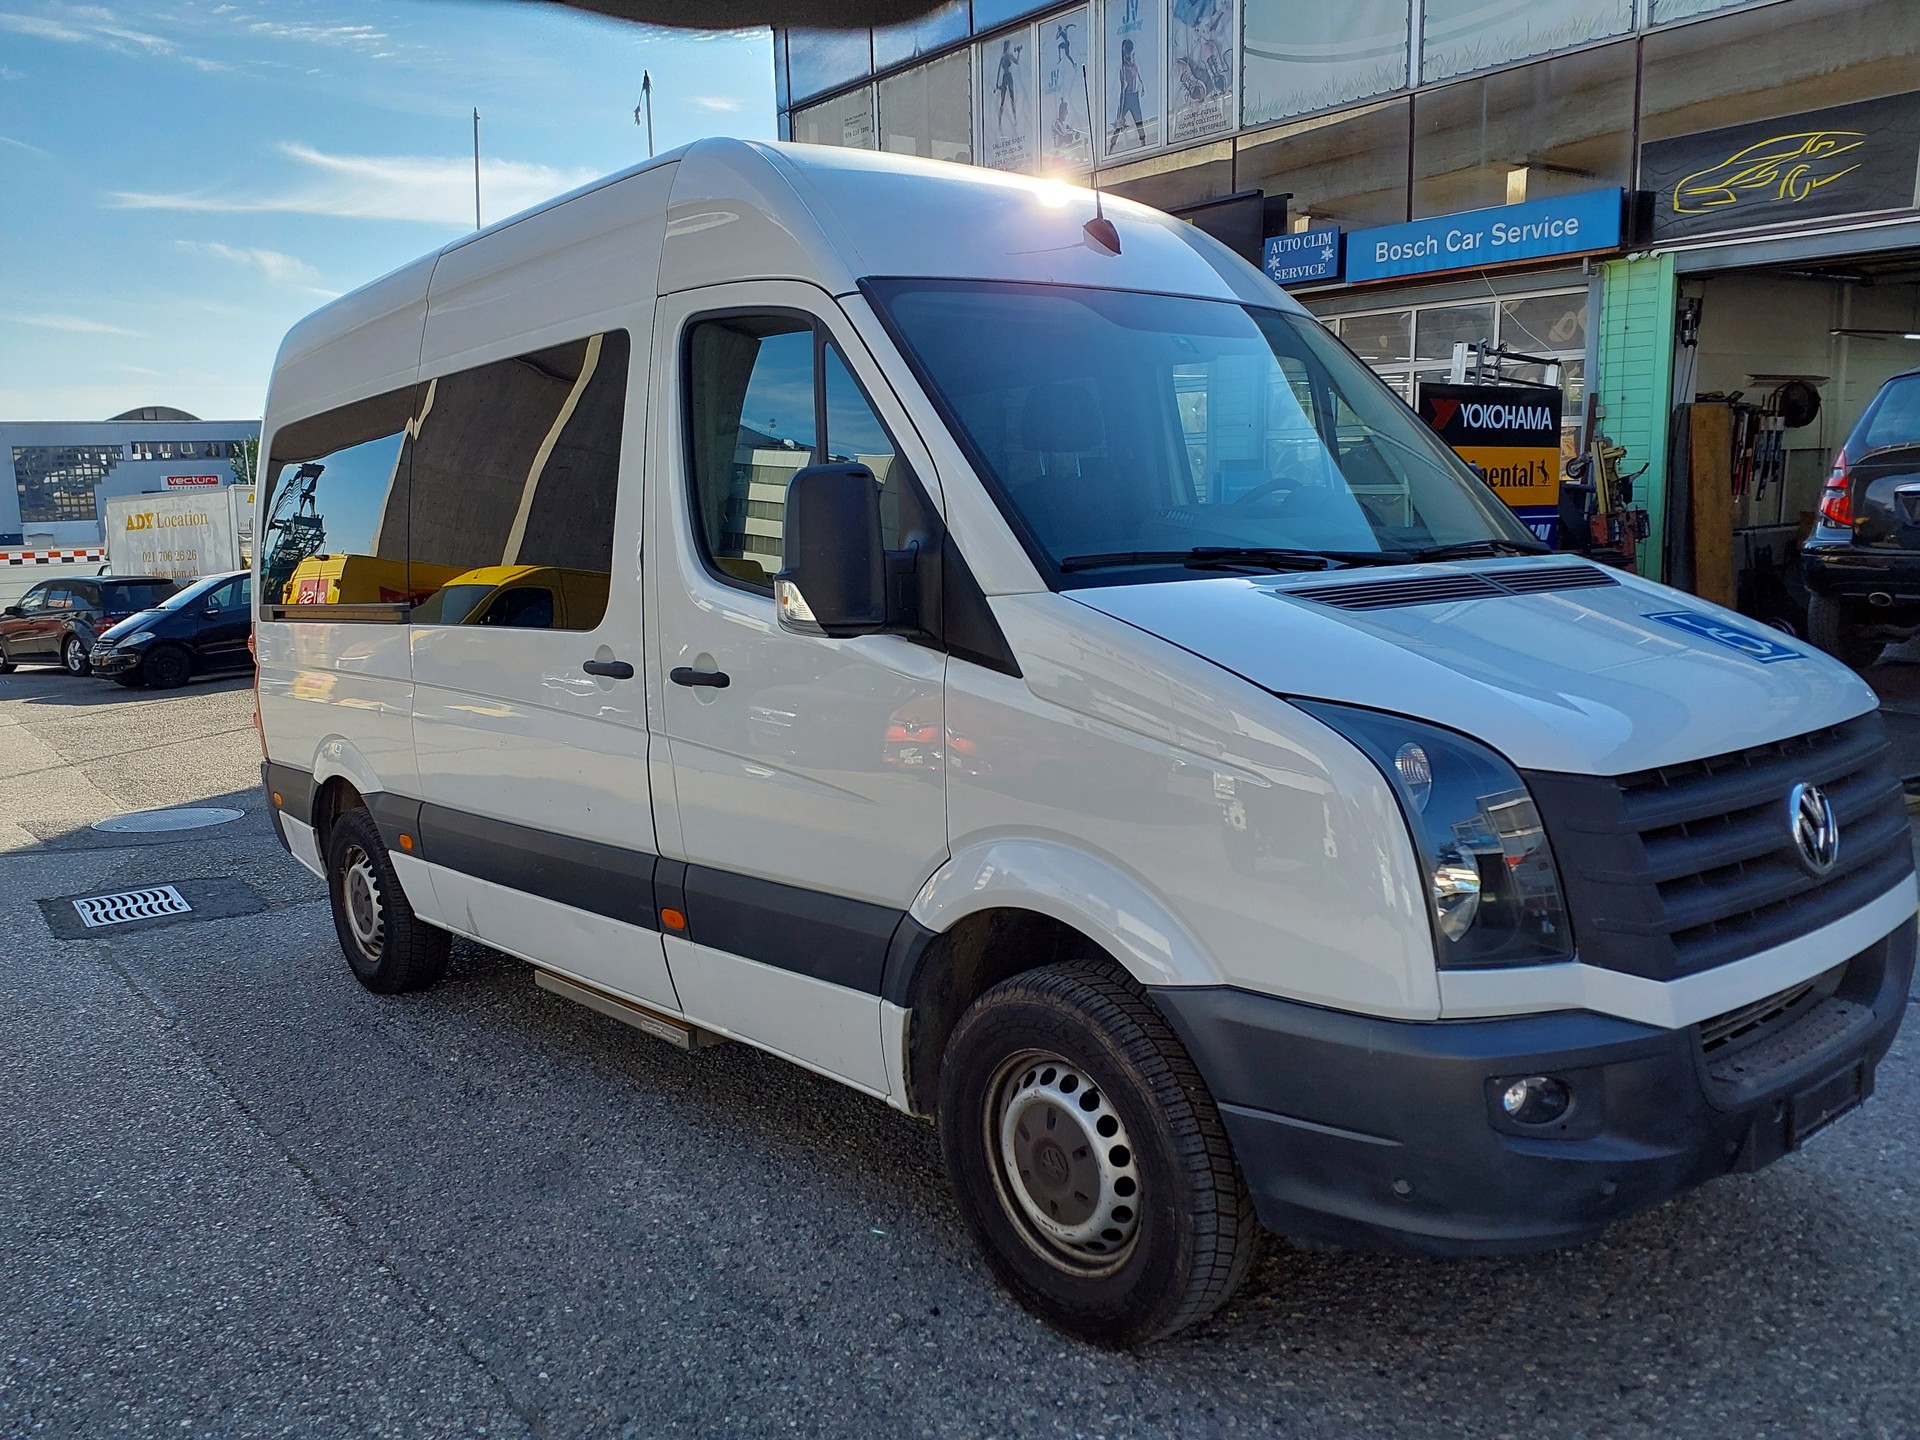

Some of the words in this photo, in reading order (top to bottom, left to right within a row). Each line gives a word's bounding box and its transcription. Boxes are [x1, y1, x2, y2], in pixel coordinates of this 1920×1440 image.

[1270, 237, 1301, 254] AUTO
[1303, 231, 1333, 249] CLIM
[1375, 234, 1438, 263] Bosch
[1446, 229, 1484, 252] Car
[1491, 216, 1579, 246] Service
[1274, 263, 1326, 281] SERVICE
[1460, 403, 1553, 431] YOKOHAMA
[1471, 460, 1534, 487] nental
[126, 512, 154, 531] ADY
[156, 509, 209, 529] Location
[142, 551, 156, 563] 021
[158, 550, 173, 562] 706
[175, 550, 185, 561] 26
[186, 549, 197, 561] 26
